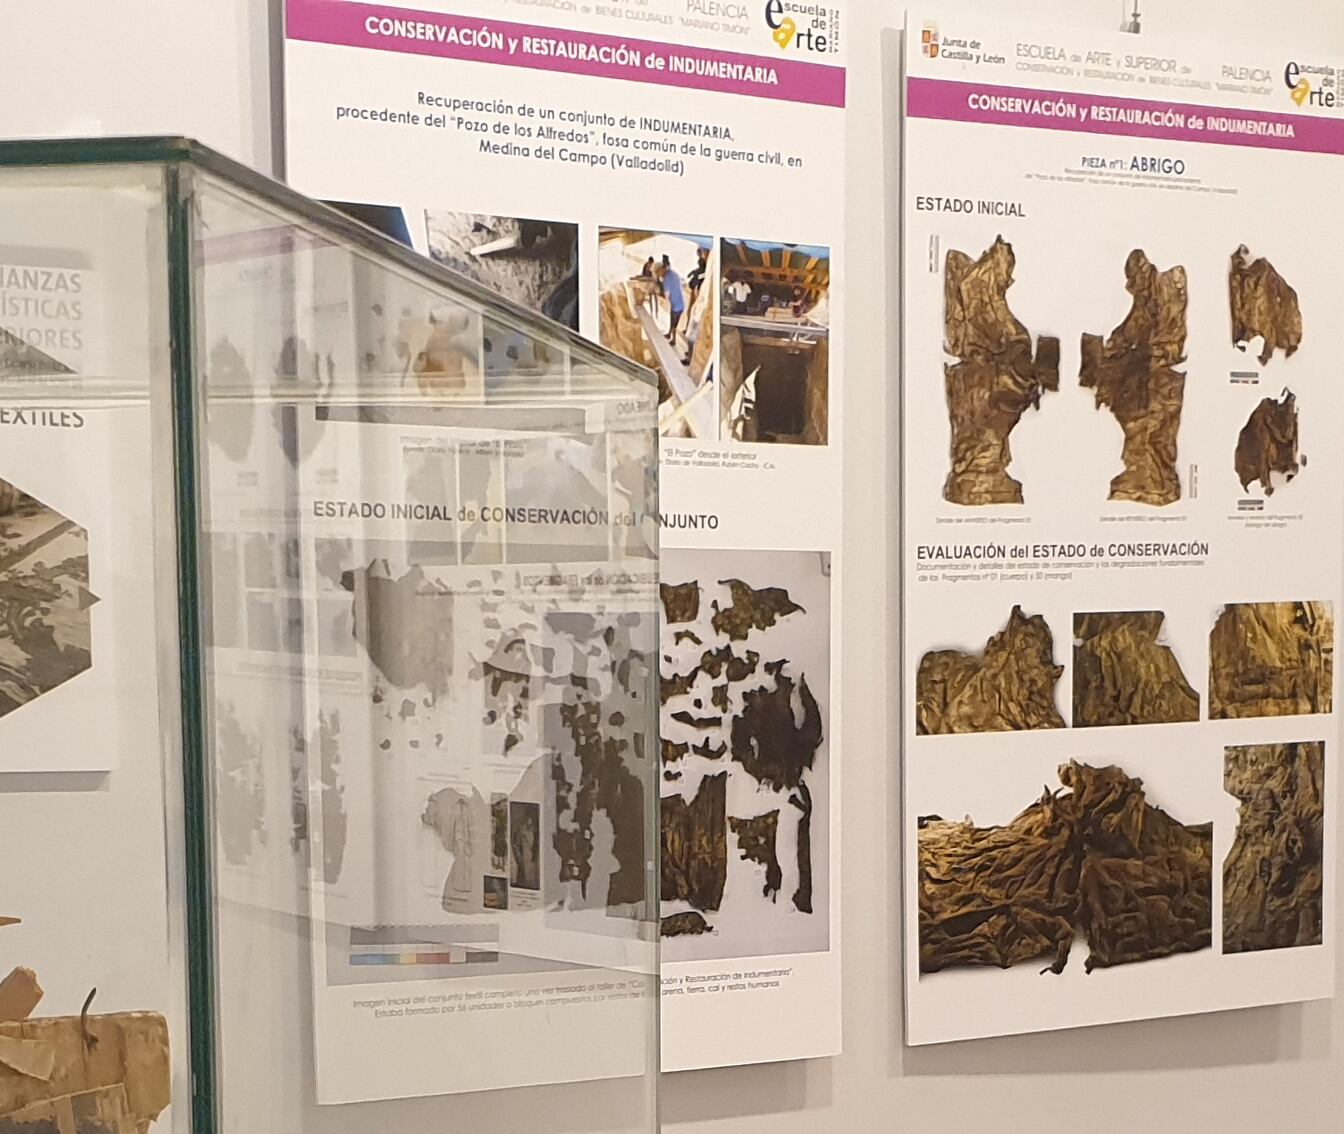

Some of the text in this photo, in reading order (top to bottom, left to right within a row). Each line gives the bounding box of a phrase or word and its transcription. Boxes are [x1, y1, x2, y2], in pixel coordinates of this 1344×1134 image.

[686, 0, 749, 20] PALENCIA
[812, 18, 827, 30] de
[365, 17, 779, 85] CONSERVACIÓN y RESTAURACIÓN de INDUMENTARIA
[941, 36, 981, 50] Junta de
[941, 49, 1006, 65] Castilla y León
[1016, 43, 1067, 61] ESCUELA
[1085, 50, 1112, 67] ARTE
[1124, 54, 1177, 73] SUPERIOR
[1221, 64, 1272, 83] PALENCIA
[417, 91, 514, 116] Recuperación
[517, 103, 535, 118] de
[539, 108, 555, 121] un
[558, 110, 616, 129] conjunto
[619, 113, 636, 130] de
[967, 93, 1296, 138] CONSERVACIÓN y RESTAURACIÓN de INDUMENTARIA
[336, 105, 420, 126] procedente
[424, 112, 446, 129] del
[492, 120, 511, 136] de
[514, 122, 532, 138] los
[602, 135, 629, 150] fosa
[632, 137, 677, 156] común
[679, 140, 697, 156] de
[700, 142, 712, 158] la
[714, 148, 754, 164] guerra
[787, 155, 803, 168] en
[479, 138, 685, 177] Medina del Campo (Valladolid)
[1081, 156, 1107, 170] PIEZA
[1130, 155, 1186, 175] ABRIGO
[916, 196, 1027, 218] ESTADO INICIAL
[313, 501, 386, 519] ESTADO
[391, 503, 453, 521] INICIAL
[457, 506, 476, 522] de
[480, 506, 609, 526] CONSERVACIÓN
[640, 512, 719, 530] NJUNTO
[917, 540, 1209, 560] EVALUACIÓN del ESTADO de CONSERVACIÓN
